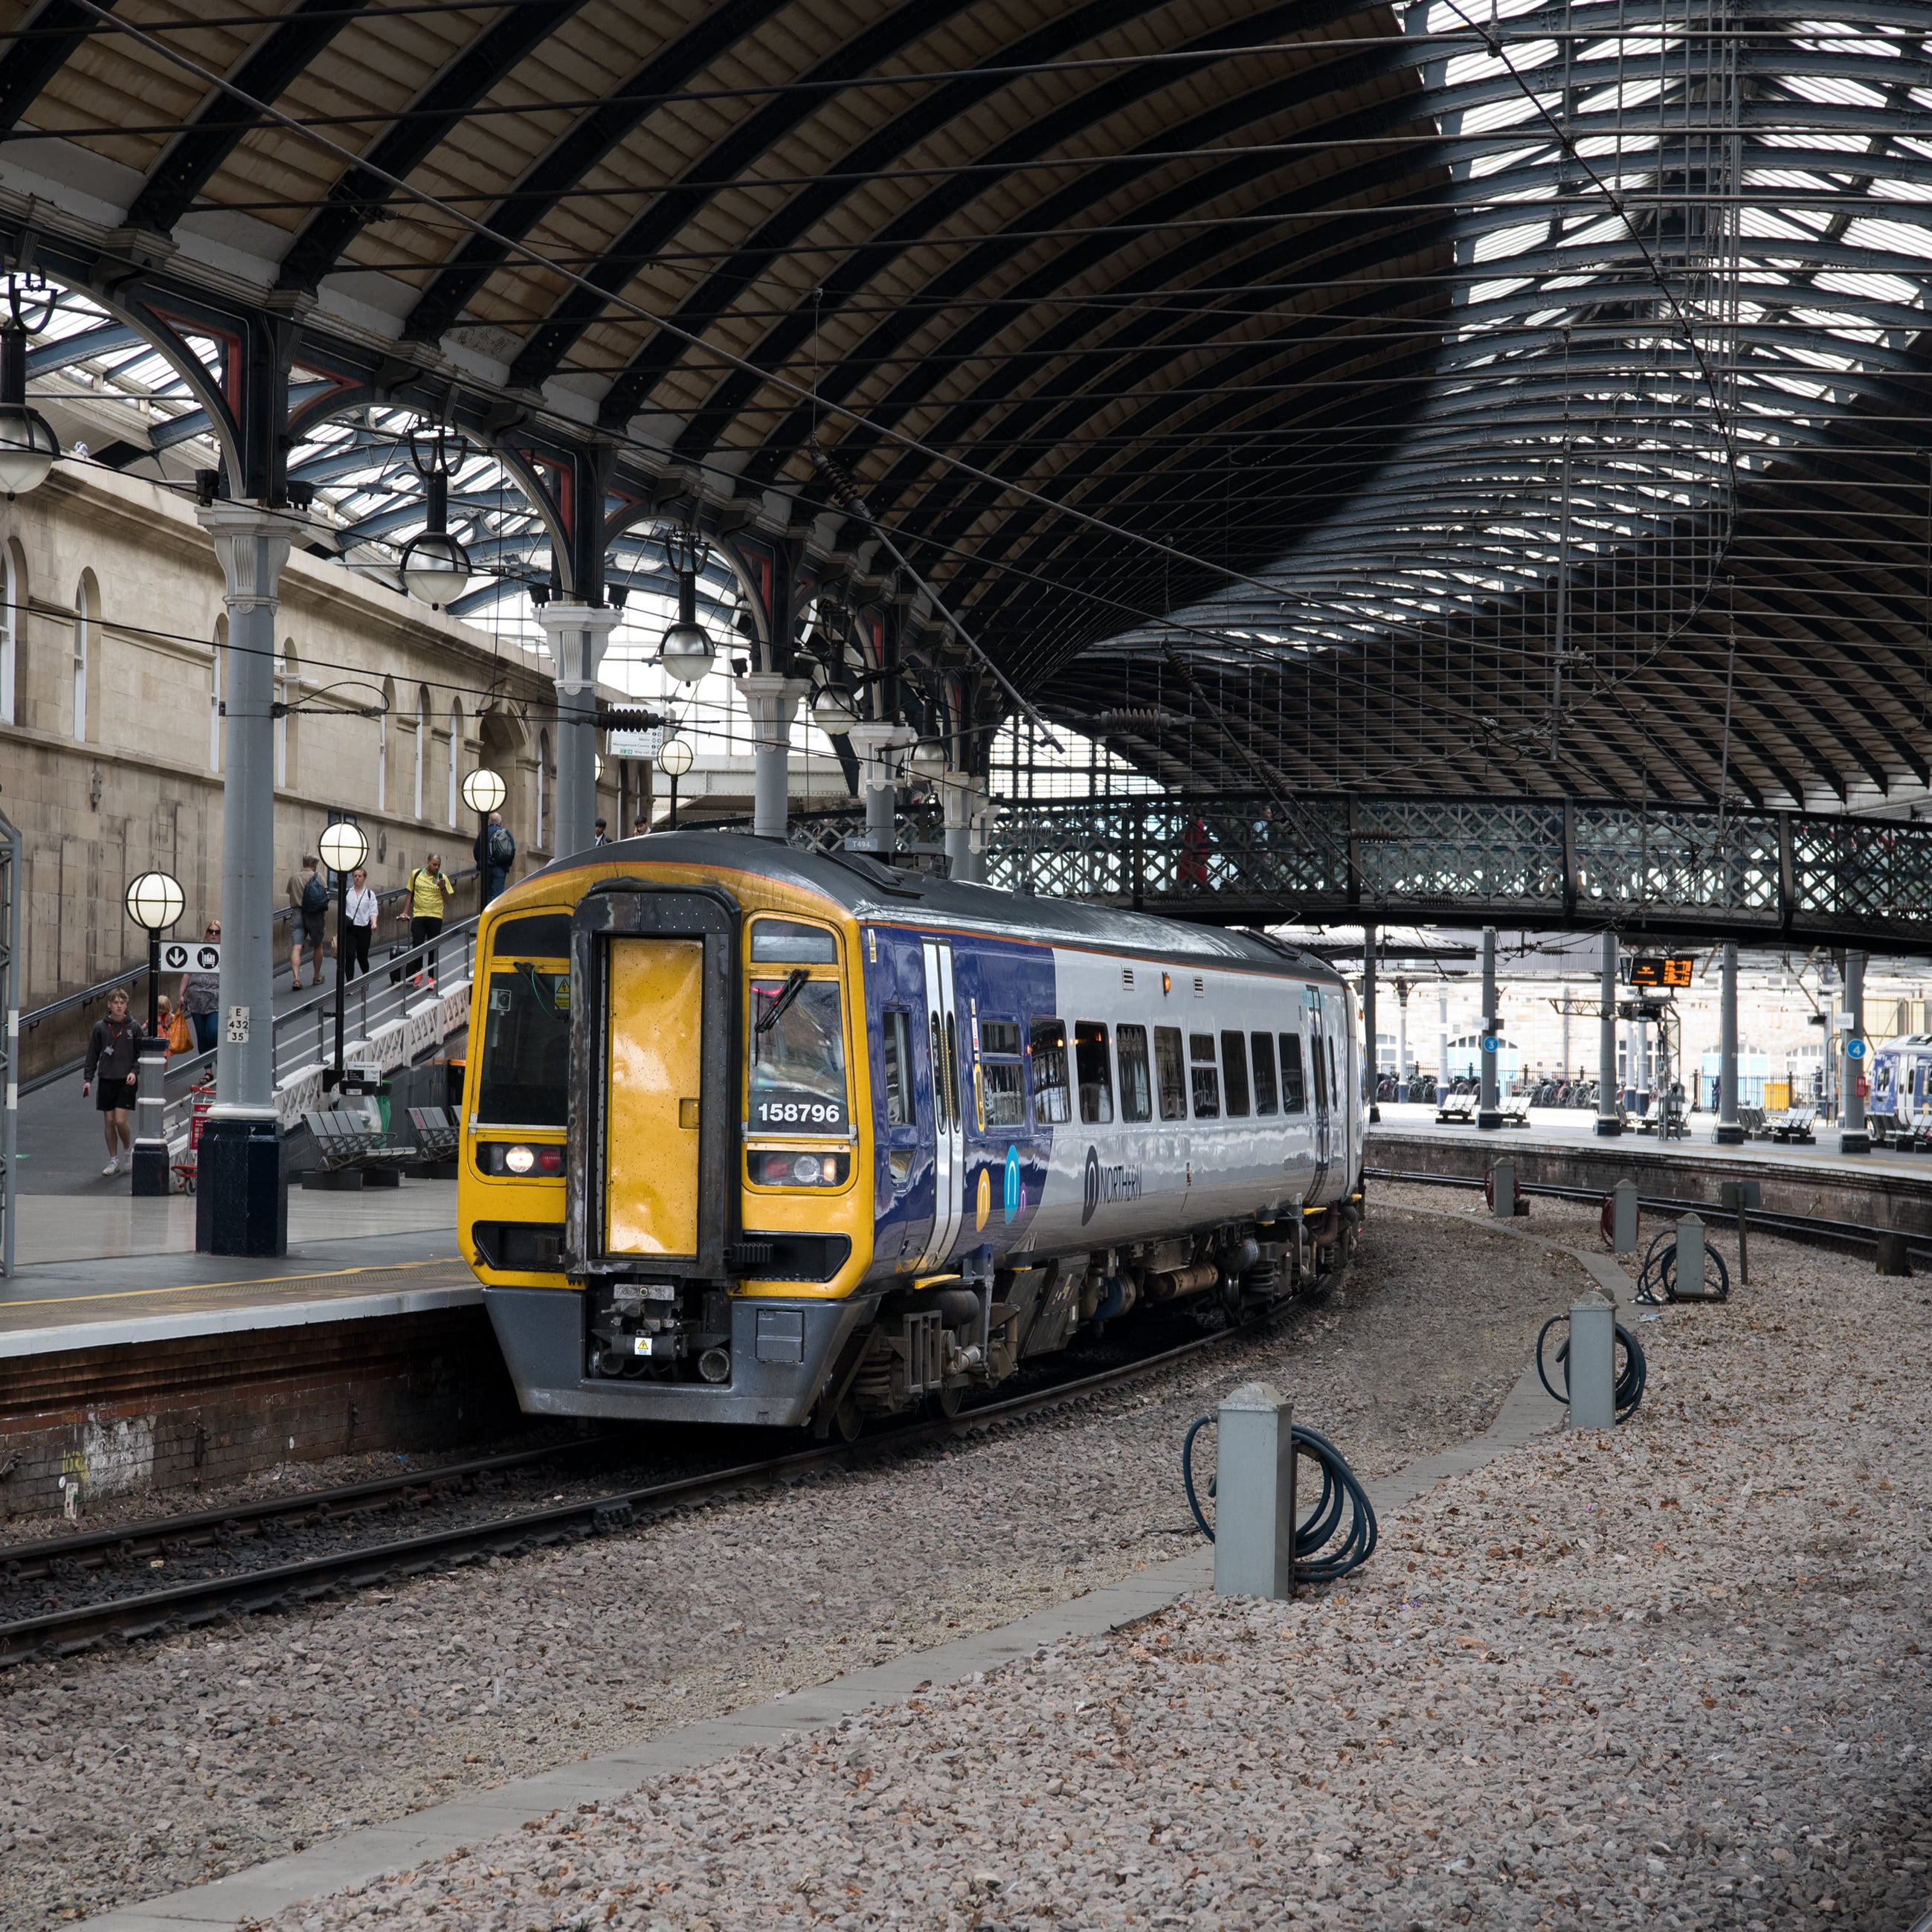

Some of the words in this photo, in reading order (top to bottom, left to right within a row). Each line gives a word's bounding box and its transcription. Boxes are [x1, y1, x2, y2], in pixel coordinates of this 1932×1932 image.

[852, 840, 871, 849] T494
[236, 1008, 242, 1017] E
[229, 1020, 248, 1029] 432
[231, 1032, 244, 1041] 35
[1488, 1041, 1494, 1049] 3
[1852, 1045, 1861, 1055] 4
[759, 1103, 840, 1123] 158796
[1100, 1164, 1142, 1204] NORTHERN
